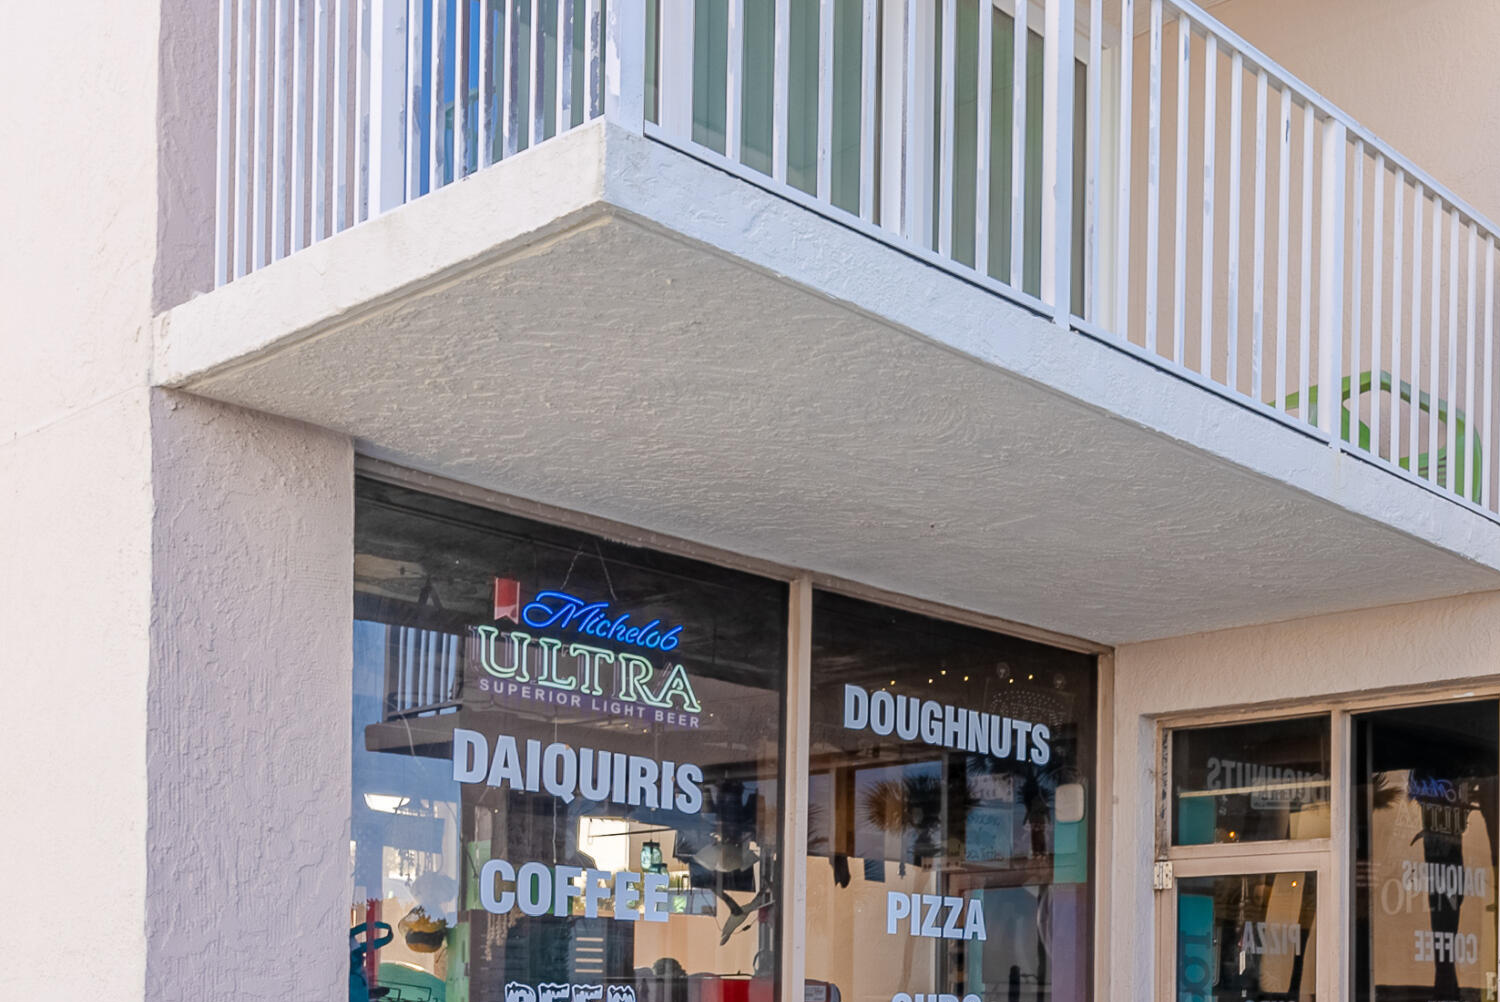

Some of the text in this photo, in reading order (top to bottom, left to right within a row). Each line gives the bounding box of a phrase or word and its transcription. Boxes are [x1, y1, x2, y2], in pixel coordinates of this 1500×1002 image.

[522, 590, 685, 651] Michelob
[477, 625, 702, 713] ULTRA
[479, 678, 700, 729] SUPERIOR LIGHT BEER
[843, 683, 1051, 765] DOUGHNUTS
[453, 727, 704, 815] DAIQUIRIS
[480, 859, 670, 922] COFFEE
[886, 891, 987, 941] PIZZA
